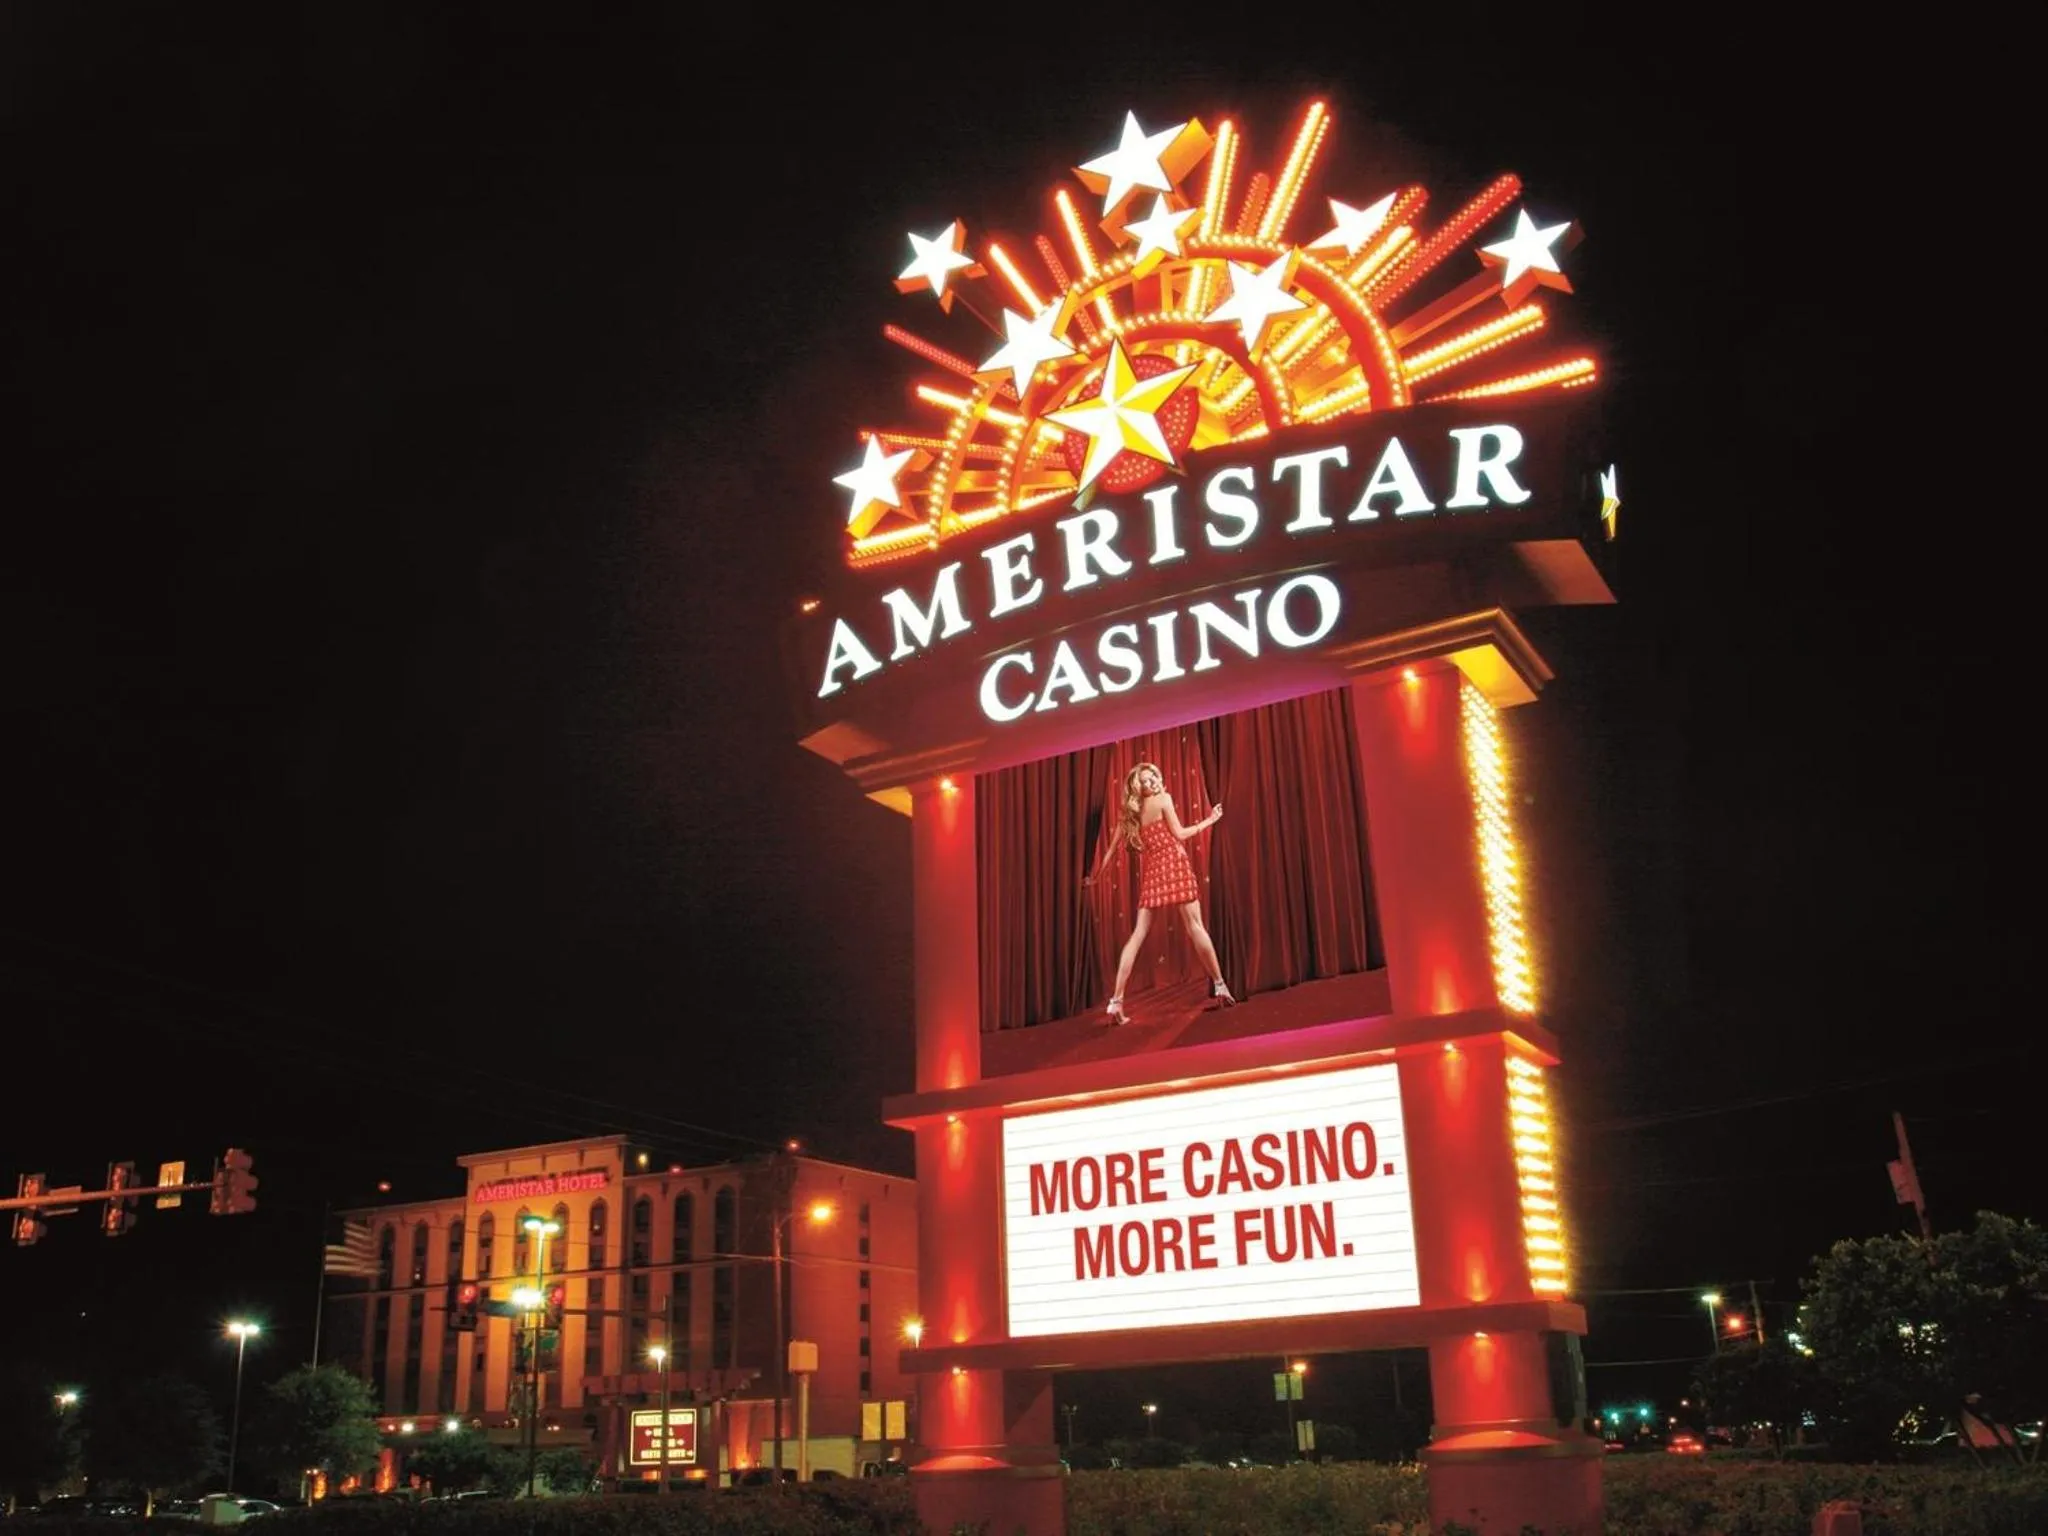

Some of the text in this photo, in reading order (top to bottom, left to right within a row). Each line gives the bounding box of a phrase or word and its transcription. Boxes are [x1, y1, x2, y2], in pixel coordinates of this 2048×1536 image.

[817, 424, 1533, 699] AMERISTAR
[979, 574, 1341, 722] CASINO
[475, 1172, 606, 1203] AMERISTAR HOTEL
[1029, 1121, 1396, 1217] MORE CASINO.
[1074, 1201, 1354, 1280] MORE FUN.
